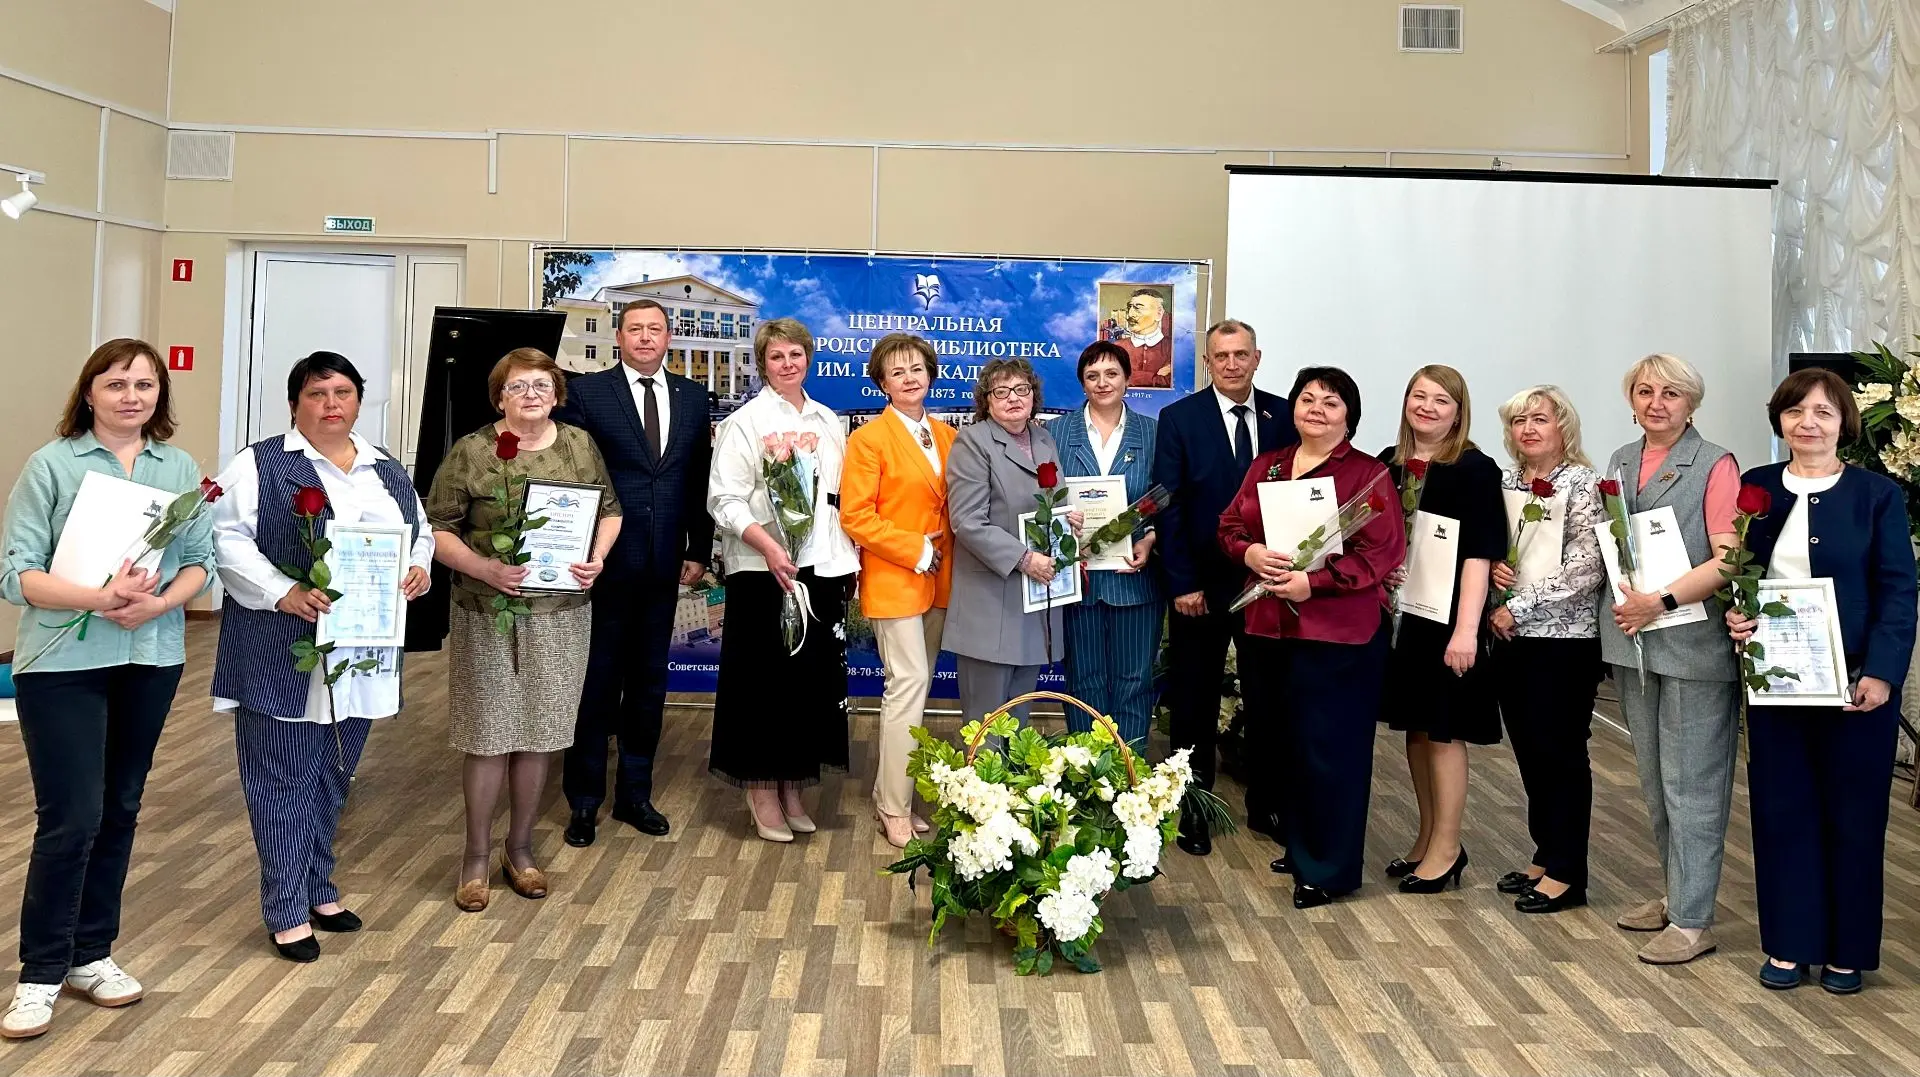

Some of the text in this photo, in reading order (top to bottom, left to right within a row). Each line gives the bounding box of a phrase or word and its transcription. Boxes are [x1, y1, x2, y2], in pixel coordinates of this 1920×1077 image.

[328, 219, 370, 231] ВЫХОД
[849, 314, 1003, 333] ЦЕНТРАЛЬНАЯ
[924, 339, 1062, 358] ИБЛИОТЕКА
[817, 361, 856, 378] ИМ.
[936, 364, 985, 383] КАД
[929, 388, 956, 399] 1873
[961, 391, 974, 399] го
[667, 661, 720, 672] Советская
[932, 671, 1066, 683] .syzr .syzra
